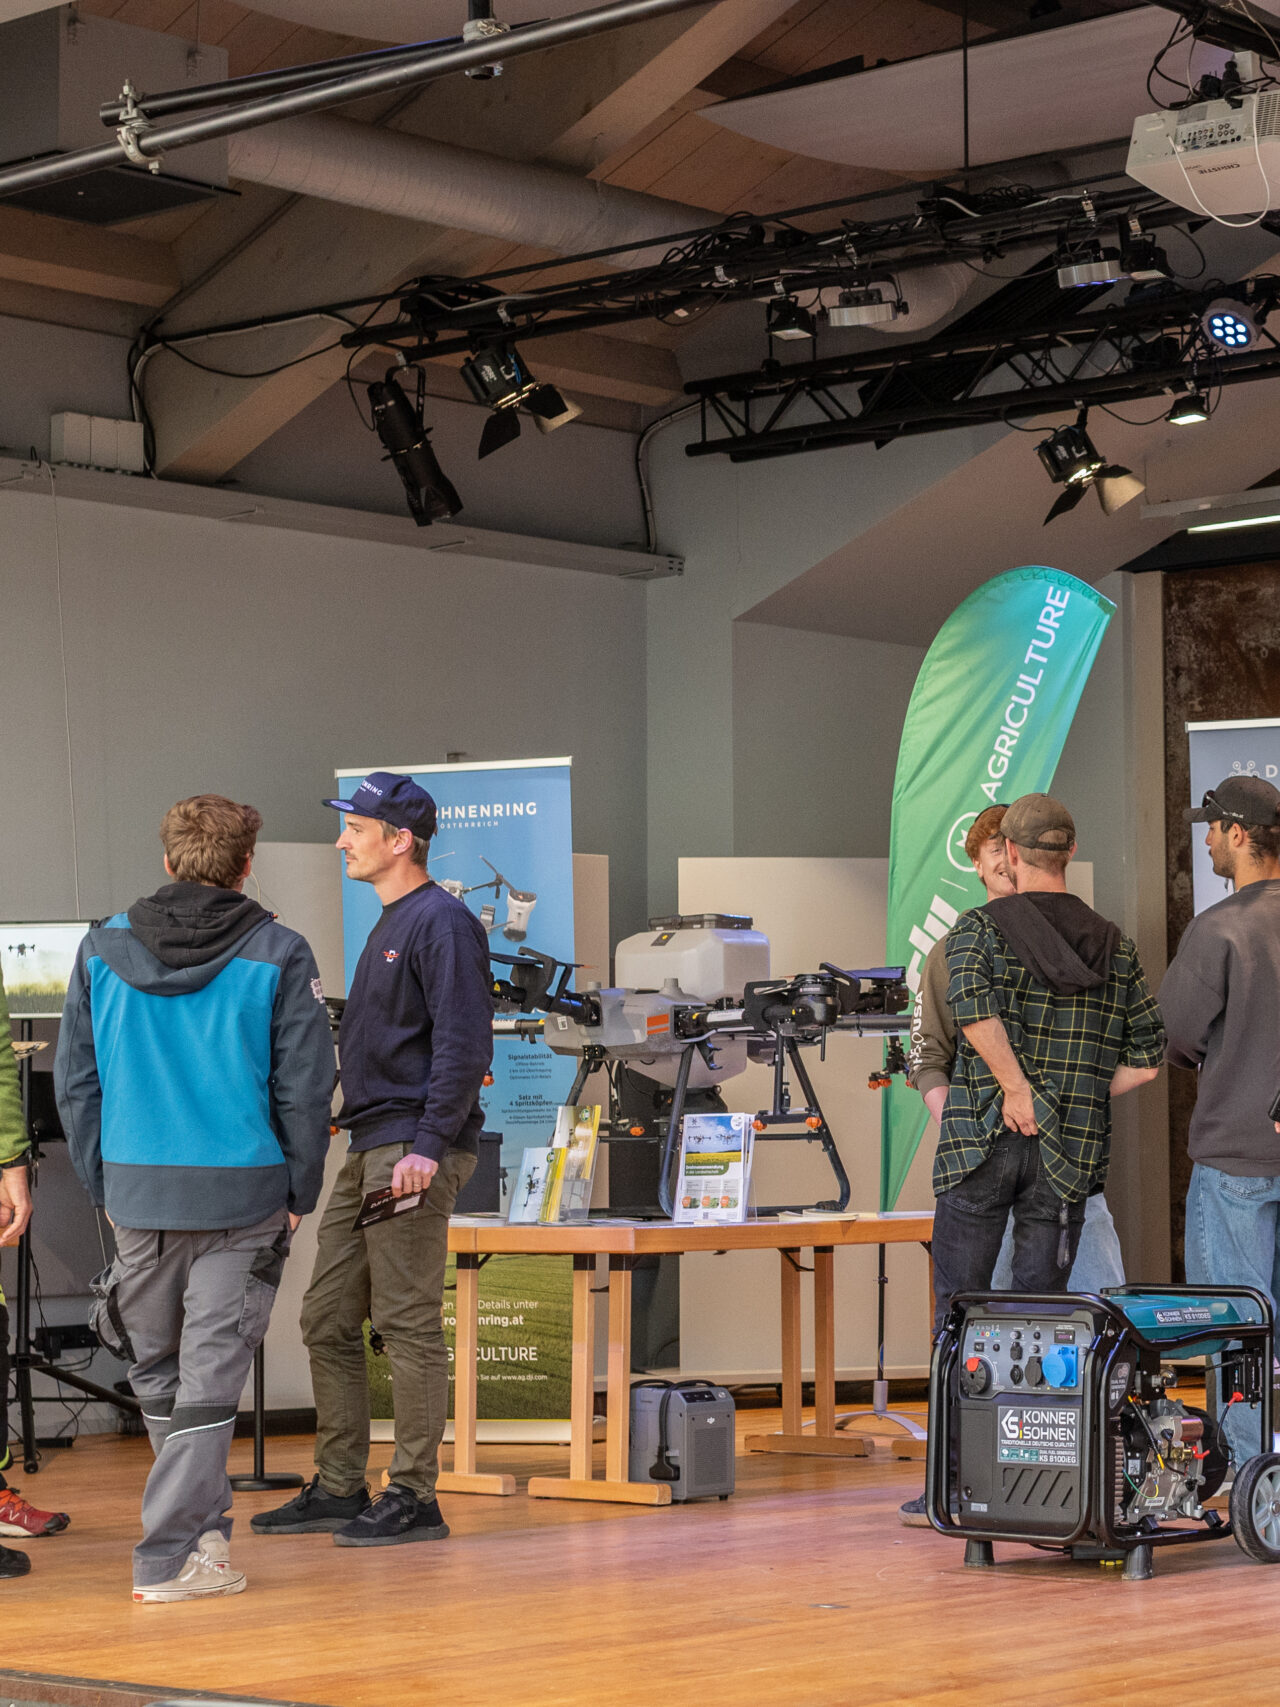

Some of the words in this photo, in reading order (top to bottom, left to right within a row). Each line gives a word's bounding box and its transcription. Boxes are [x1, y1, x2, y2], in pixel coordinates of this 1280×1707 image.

[980, 586, 1070, 803] AGRICULTURE
[437, 801, 537, 820] HNENRING
[478, 1300, 511, 1310] Details
[513, 1300, 538, 1309] unter
[1023, 1410, 1076, 1425] KONNER
[1023, 1426, 1076, 1441] SOHNEN
[1050, 1456, 1076, 1464] 8100iEG
